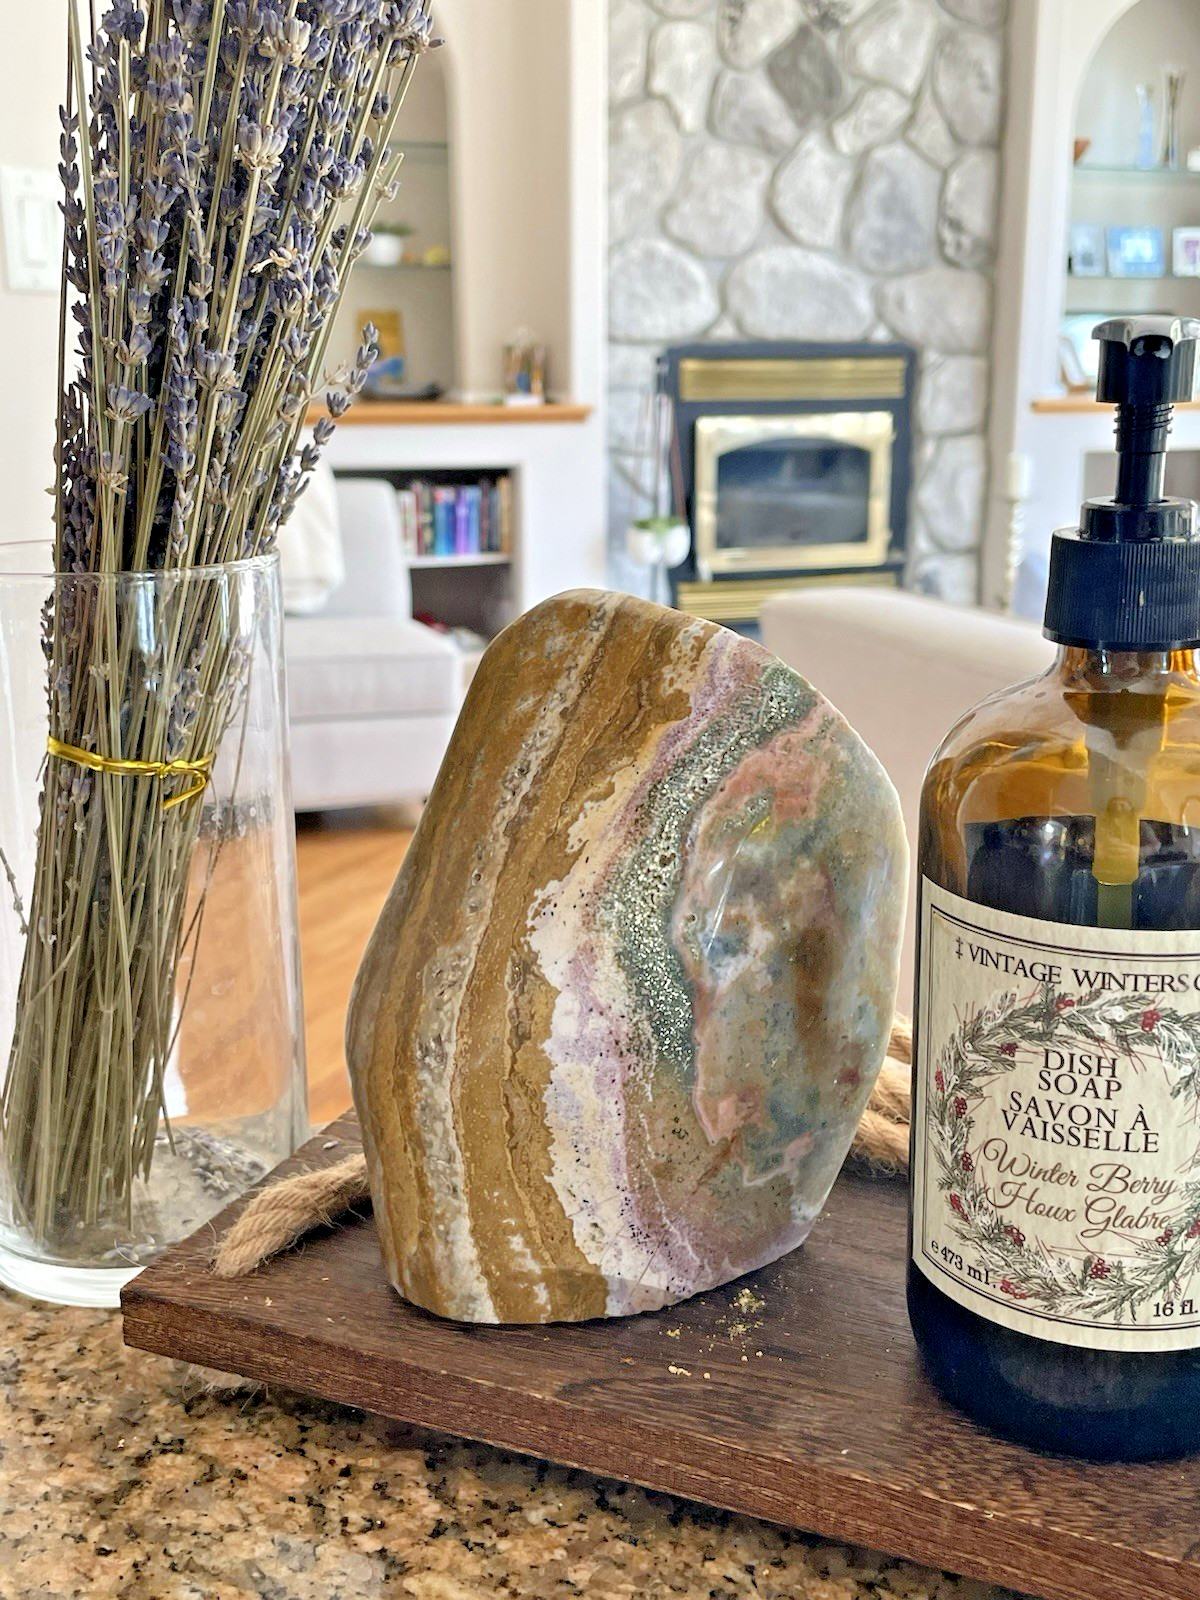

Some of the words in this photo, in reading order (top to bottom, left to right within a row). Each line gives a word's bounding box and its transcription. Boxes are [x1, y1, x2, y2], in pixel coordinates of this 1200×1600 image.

[967, 942, 1062, 984] VINTAGE
[1043, 1049, 1118, 1079] DISH
[1038, 1071, 1122, 1101] SOAP
[1001, 1109, 1160, 1154] VAISSELLE
[1009, 1091, 1120, 1130] SAVON
[1129, 1103, 1150, 1131] À
[983, 1137, 1080, 1188] Winter
[1086, 1163, 1179, 1206] Berry
[985, 1181, 1077, 1223] Houx
[1080, 1195, 1171, 1238] Glabre
[1153, 1302, 1174, 1317] 16
[1179, 1299, 1199, 1316] fl.
